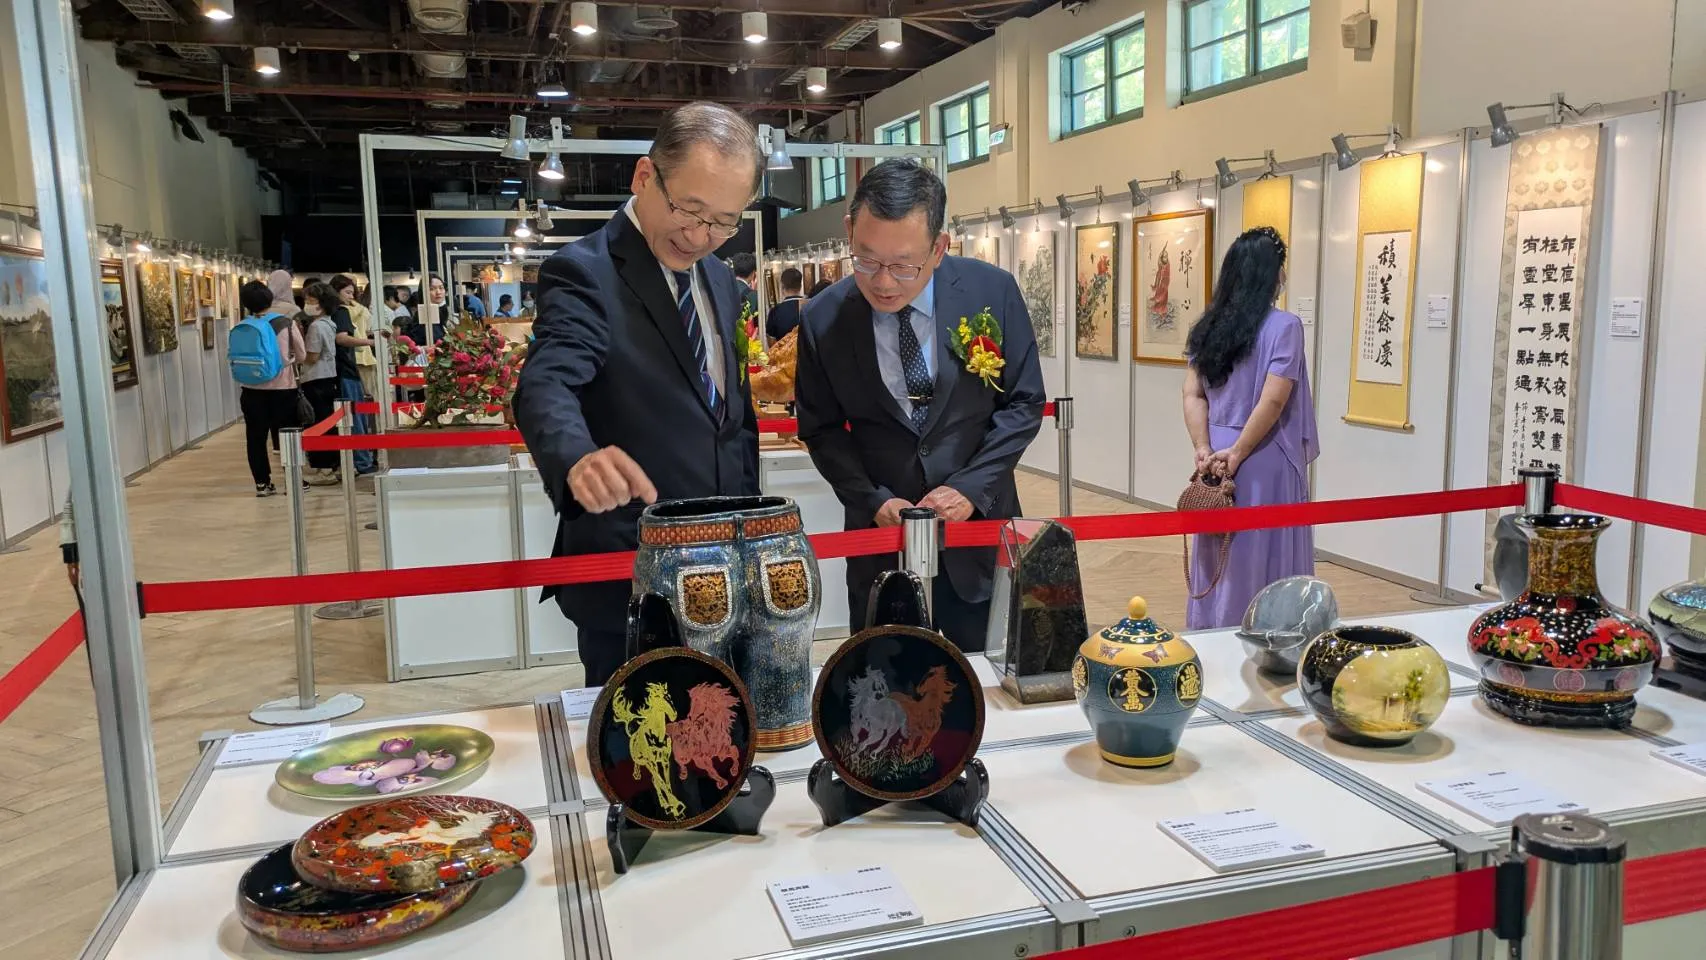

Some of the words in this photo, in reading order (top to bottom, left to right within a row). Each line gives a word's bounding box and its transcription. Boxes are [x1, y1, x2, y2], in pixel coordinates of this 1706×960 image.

[1179, 249, 1193, 310] 禪心
[1376, 238, 1396, 367] 積善餘慶
